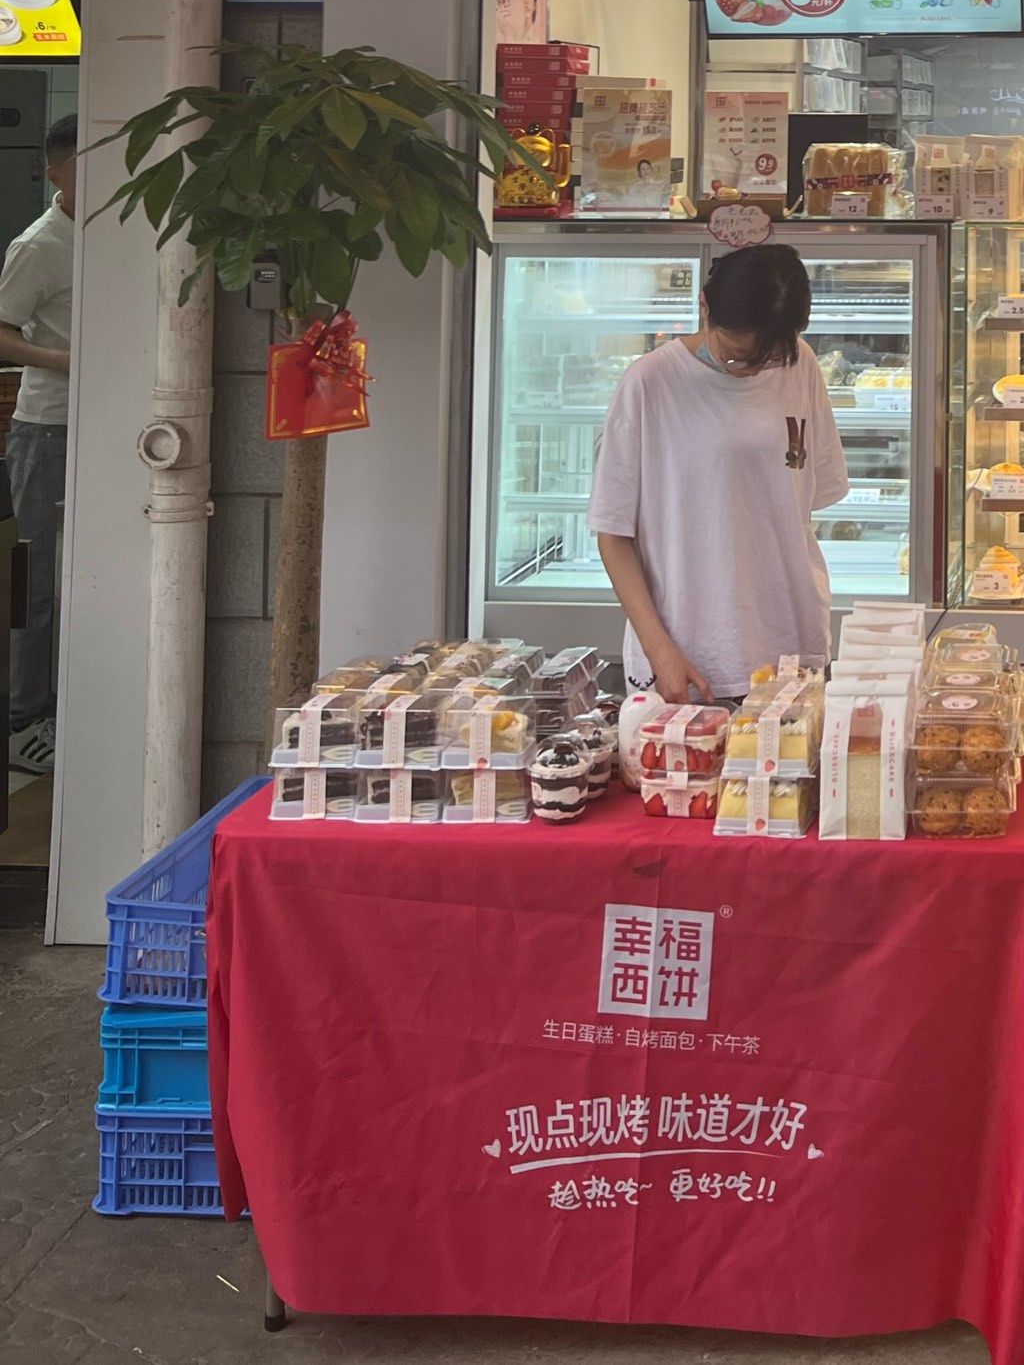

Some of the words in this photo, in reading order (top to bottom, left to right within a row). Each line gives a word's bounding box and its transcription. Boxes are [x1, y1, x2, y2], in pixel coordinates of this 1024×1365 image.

[848, 205, 857, 213] 12
[933, 205, 942, 213] 10
[1011, 306, 1024, 315] 2.5
[613, 916, 702, 962] 幸福
[610, 962, 699, 1008] 西饼
[505, 1094, 651, 1158] 现点现烤
[657, 1092, 808, 1151] 味道才好
